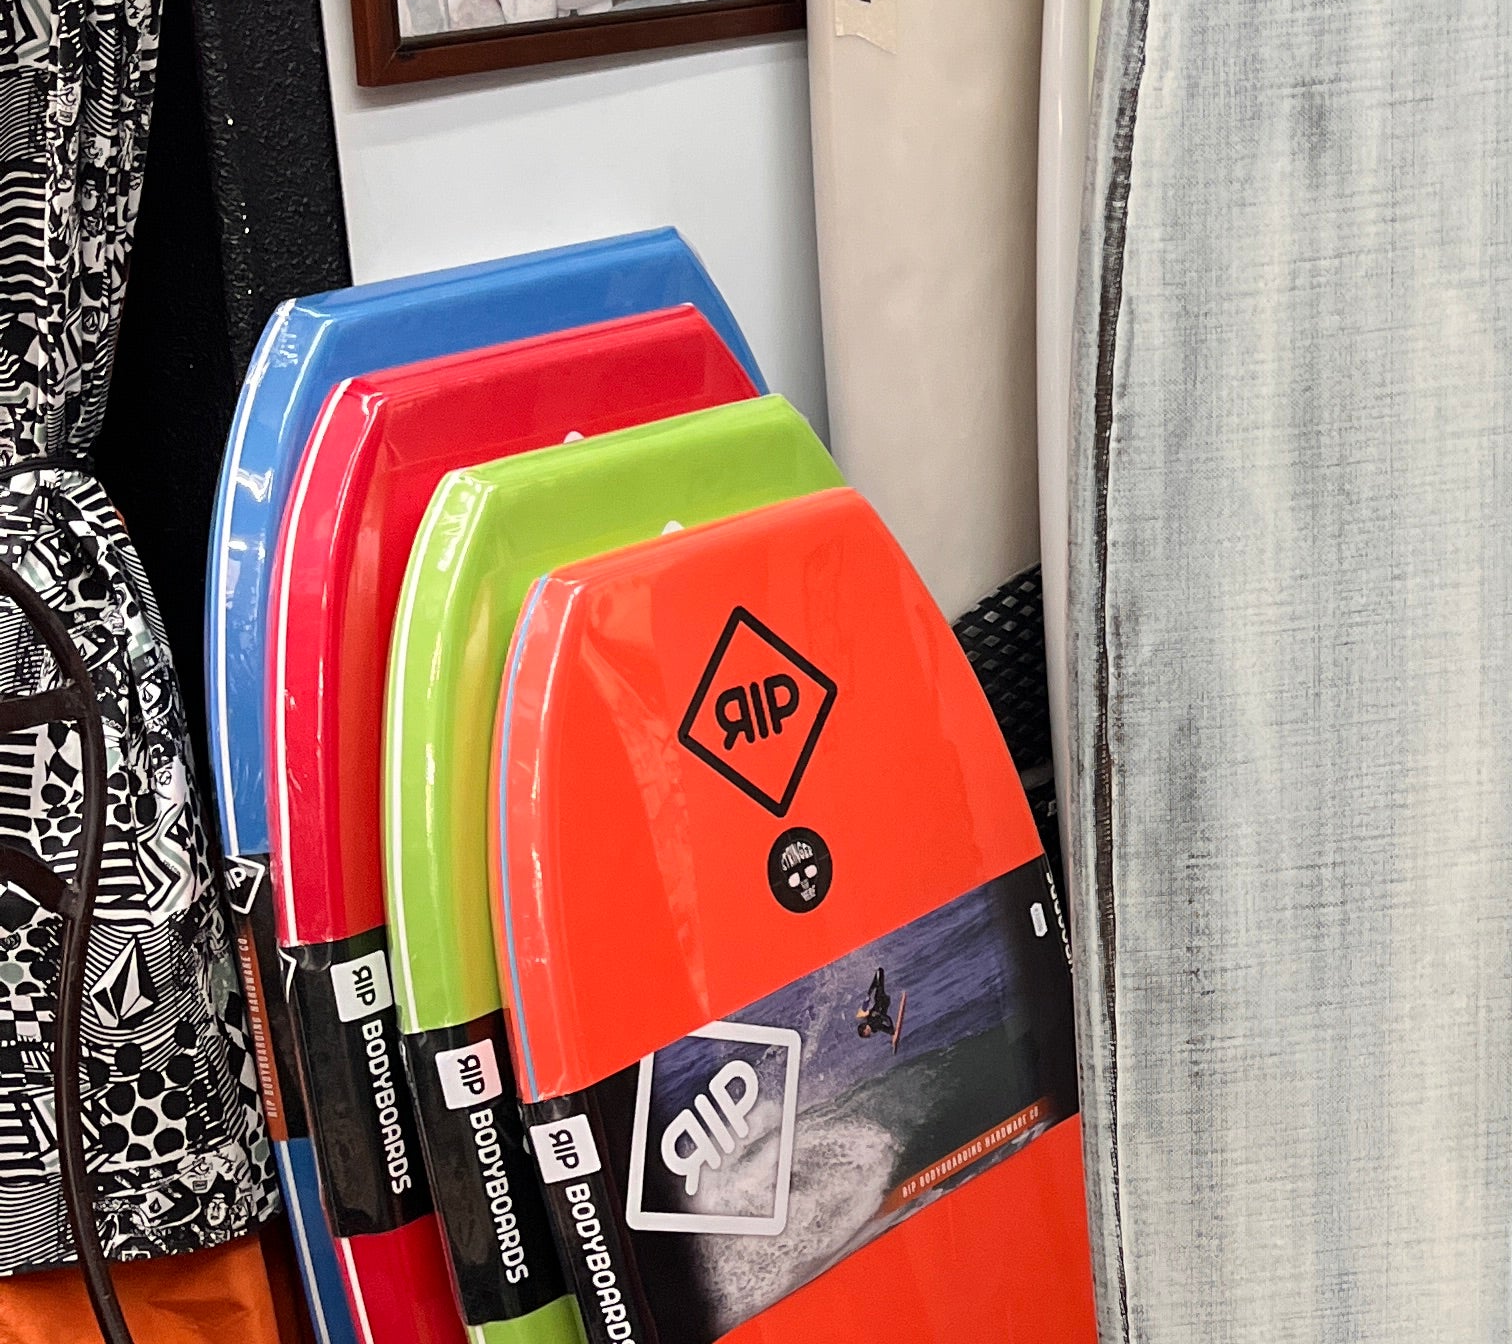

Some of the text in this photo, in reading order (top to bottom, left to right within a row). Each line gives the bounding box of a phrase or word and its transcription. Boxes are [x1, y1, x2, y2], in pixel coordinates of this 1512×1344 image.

[239, 955, 261, 1014] HARDWARE
[250, 1015, 278, 1099] BODYBOARDING
[362, 1019, 412, 1195] BODYBOARDS
[919, 1140, 983, 1188] BODYBOARDING
[984, 1113, 1028, 1149] HARDWARE
[469, 1108, 529, 1284] BODYBOARDS
